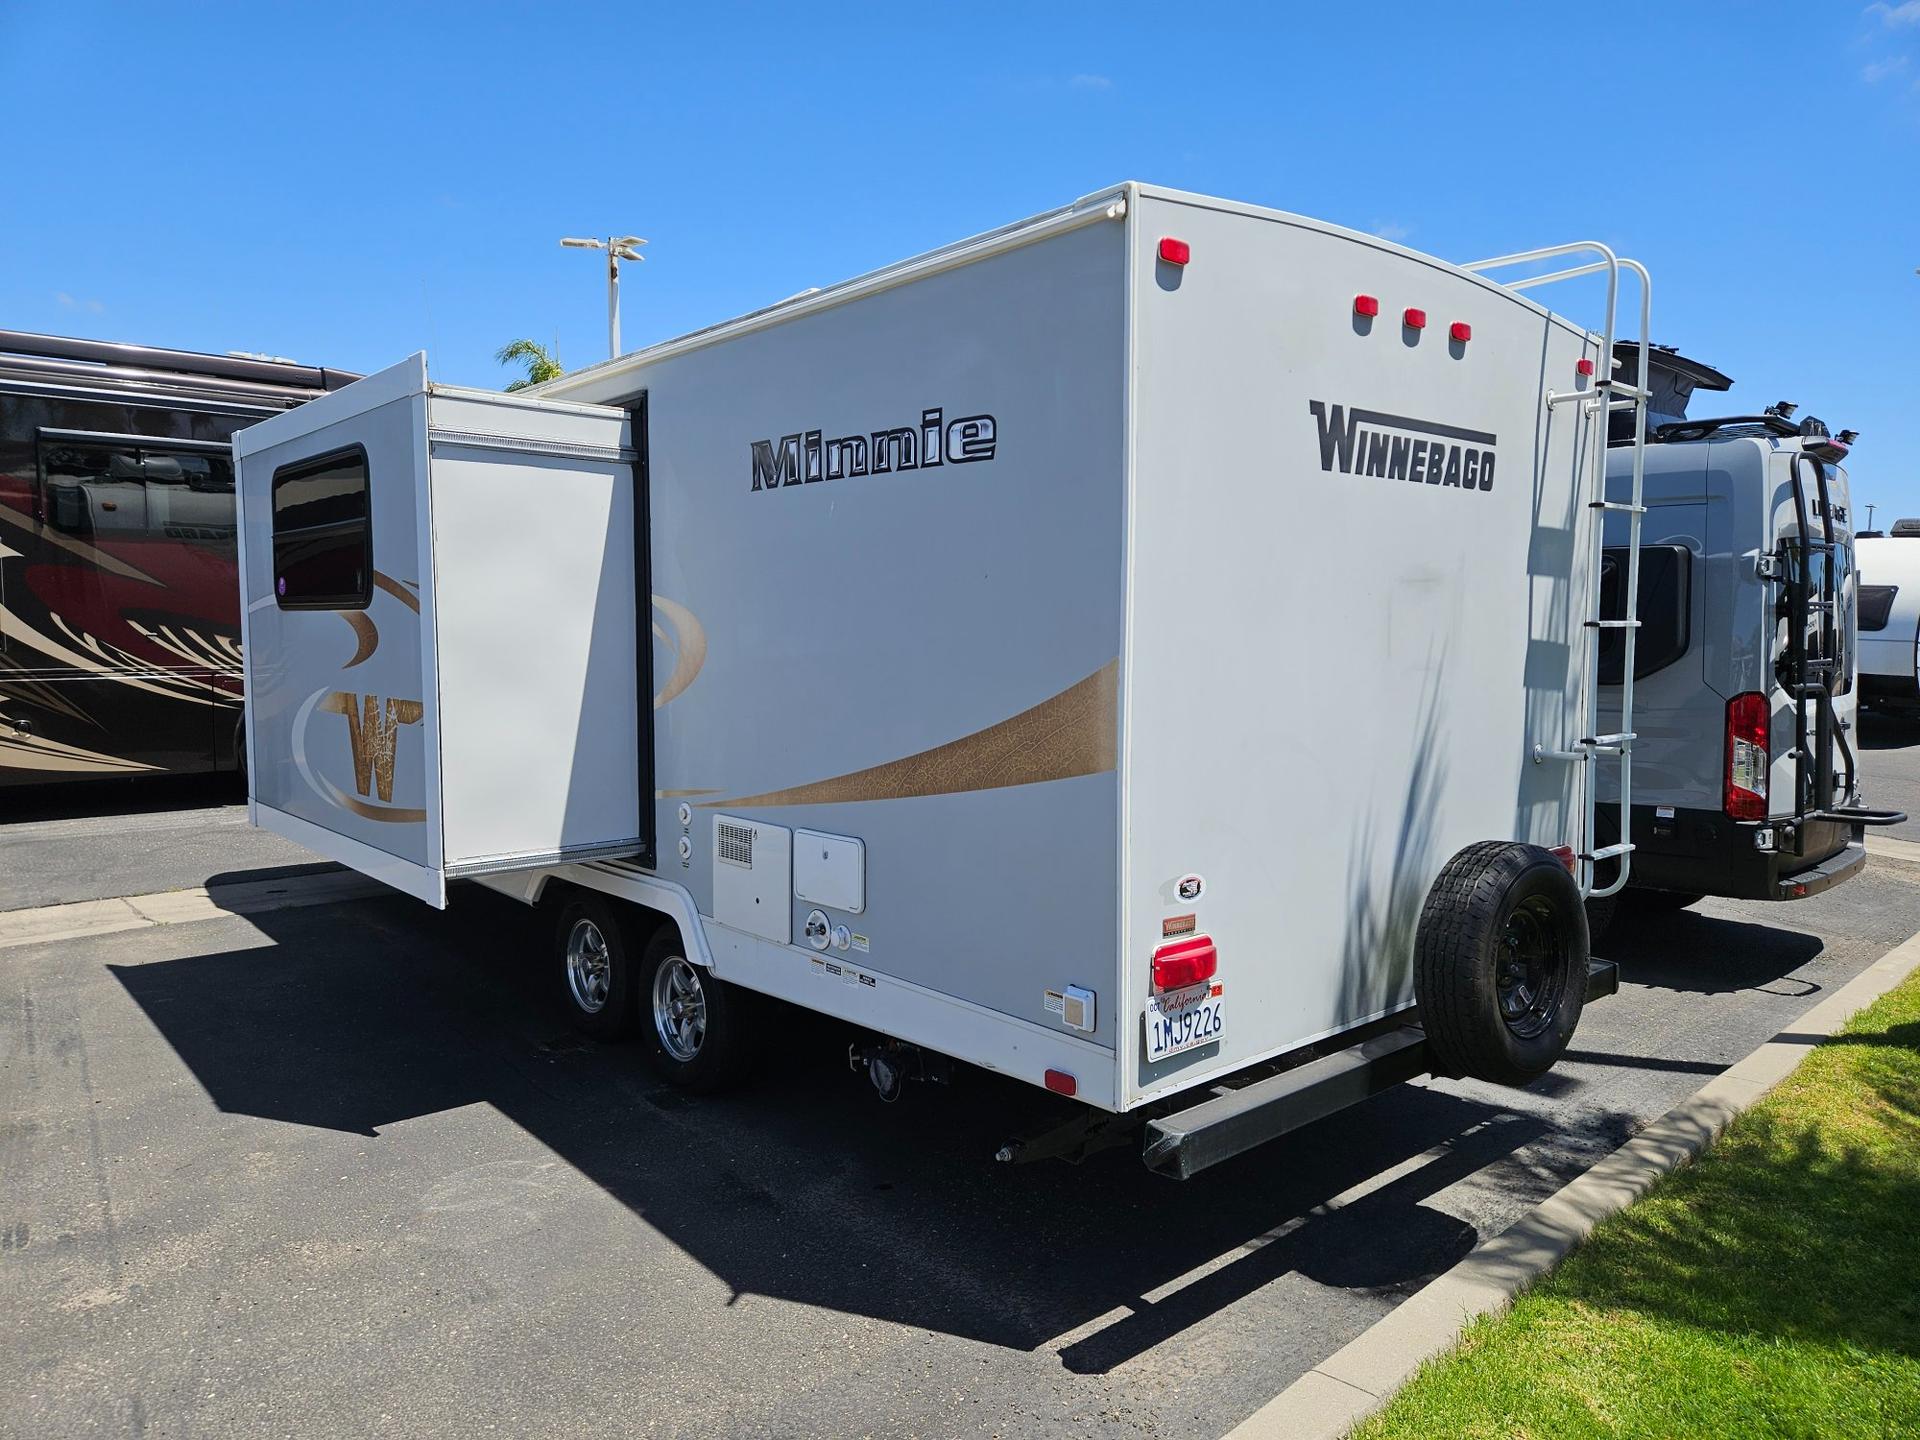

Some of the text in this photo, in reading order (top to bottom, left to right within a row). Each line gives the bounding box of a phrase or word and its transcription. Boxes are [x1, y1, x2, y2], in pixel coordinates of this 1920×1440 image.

[750, 407, 998, 492] Minnie
[1309, 399, 1497, 492] WINNEBAGO
[1154, 1003, 1222, 1053] 1MJ9226
[1163, 990, 1207, 1013] California
